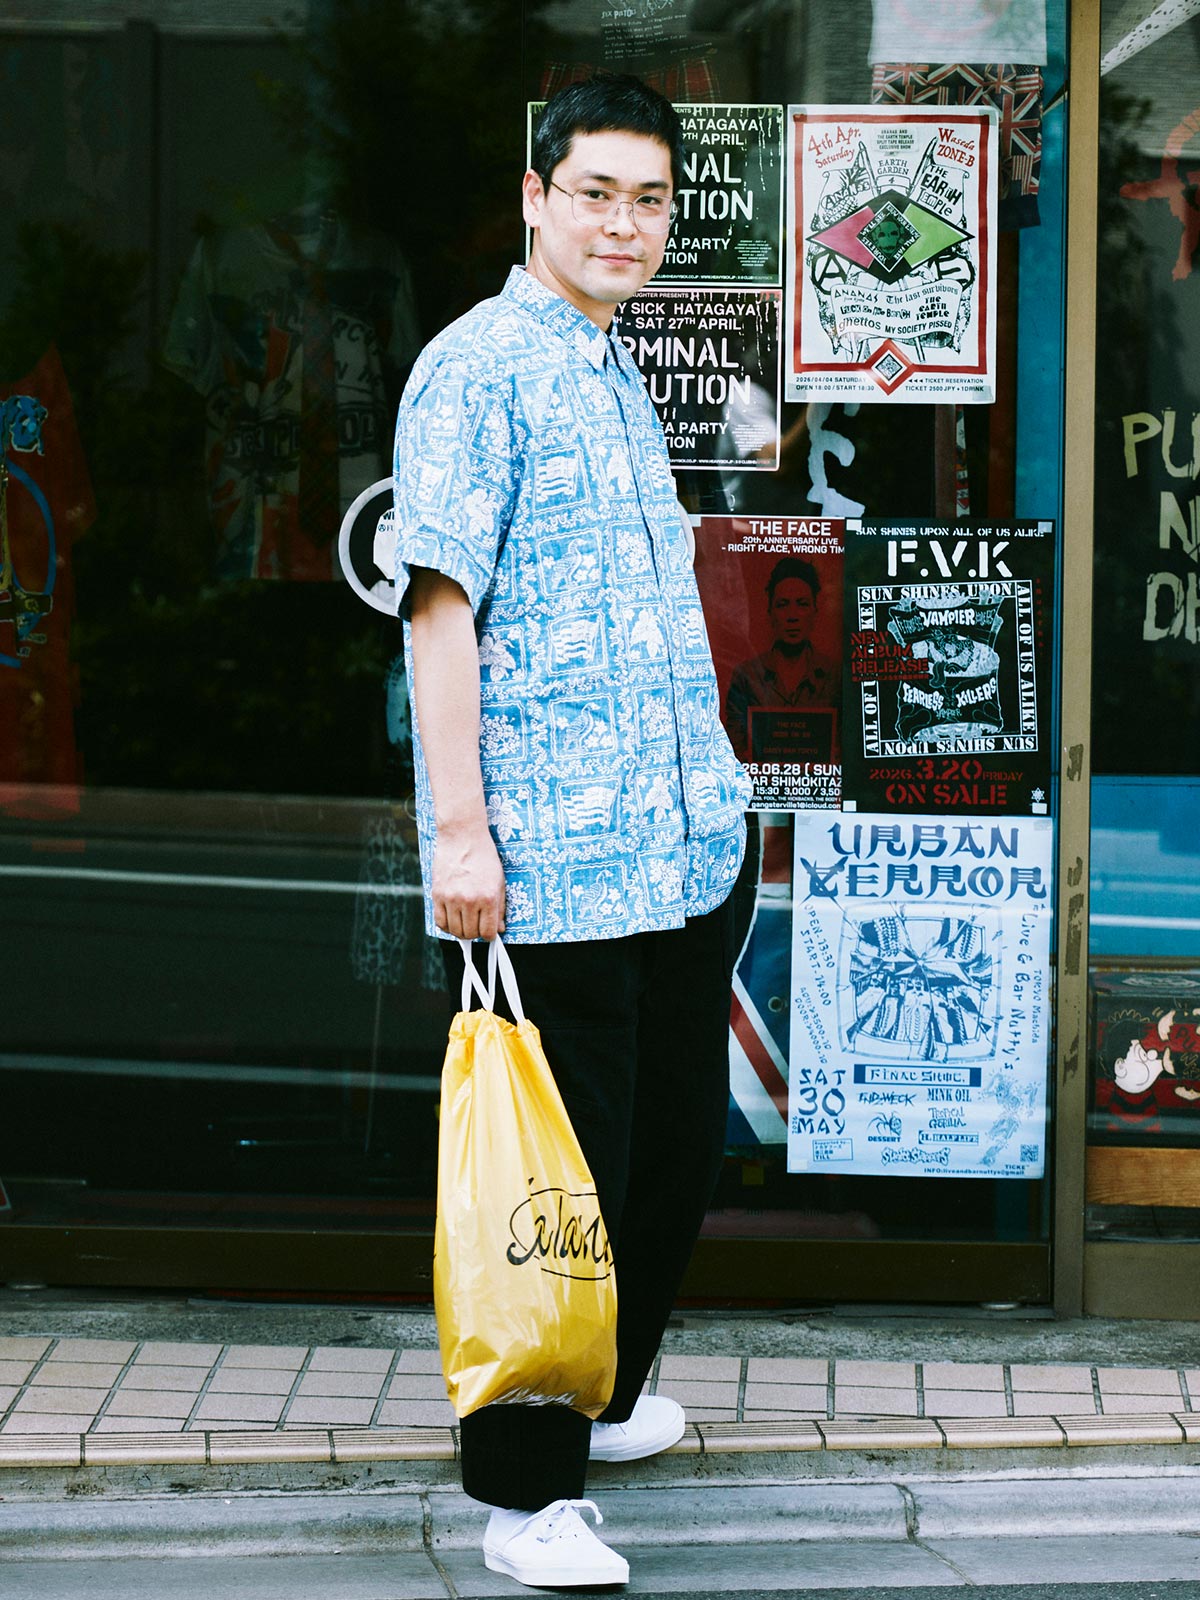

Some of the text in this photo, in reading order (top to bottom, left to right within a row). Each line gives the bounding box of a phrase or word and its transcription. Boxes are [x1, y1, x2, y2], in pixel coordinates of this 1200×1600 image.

[700, 133, 744, 146] APRIL
[808, 126, 862, 157] 4th Apr.
[938, 127, 976, 151] Waseda
[815, 148, 855, 169] Saturday
[878, 159, 908, 167] EARTH
[937, 144, 976, 168] ZONE-B
[684, 152, 742, 184] NAL
[877, 166, 910, 175] GARDEN
[930, 165, 949, 178] THE
[678, 189, 753, 221] TION
[681, 237, 731, 251] PARTY
[663, 252, 698, 265] TION
[834, 289, 878, 304] ANANAS
[630, 302, 665, 314] SICK
[673, 303, 756, 316] HATAGAYA
[635, 318, 664, 330] SAT
[668, 317, 695, 330] 27TH
[698, 318, 742, 331] APRIL
[838, 316, 882, 332] ghettos
[884, 319, 953, 335] MY SOCIETY PISSED
[618, 336, 740, 368] RMINAL
[645, 373, 752, 405] UTION
[679, 422, 728, 435] PARTY
[664, 436, 696, 449] ION
[383, 511, 395, 520] WI
[749, 520, 831, 536] THE FACE
[881, 527, 917, 536] SHINES
[920, 528, 949, 536] UPON
[952, 528, 974, 537] ALL
[977, 529, 992, 537] OF
[996, 529, 1010, 537] US
[743, 536, 839, 545] 20th ANNIVERSARY LIVE
[728, 544, 756, 552] RIGHT
[758, 545, 791, 554] PLACE,
[792, 545, 827, 554] WRONG
[830, 545, 845, 554] TIM
[861, 582, 1012, 601] SUN SHINES UPON
[851, 631, 889, 645] NEW
[851, 645, 913, 659] ALBUM
[1017, 584, 1035, 732] ALL OF US ALIKE
[851, 658, 930, 674] RELEASE
[864, 693, 878, 714] OF
[865, 720, 880, 753] ALL
[884, 737, 1035, 755] SUN SHINES UPON
[743, 762, 801, 775] 26.06.28
[983, 771, 1024, 781] FRIDAY
[752, 776, 842, 788] AR SHIMOKITAZ
[755, 787, 780, 795] 15:30
[784, 787, 811, 796] 3,000
[820, 788, 842, 796] 3,50
[885, 783, 1008, 805] ON SALE
[827, 822, 1019, 860] URBAN
[1019, 913, 1038, 946] Live
[1013, 972, 1031, 1001] Bar
[1031, 969, 1042, 1044] TOKYO Machida
[799, 1068, 846, 1086] SAT
[798, 1087, 846, 1117] 30
[927, 1088, 953, 1102] MINK
[797, 1117, 846, 1135] MAY
